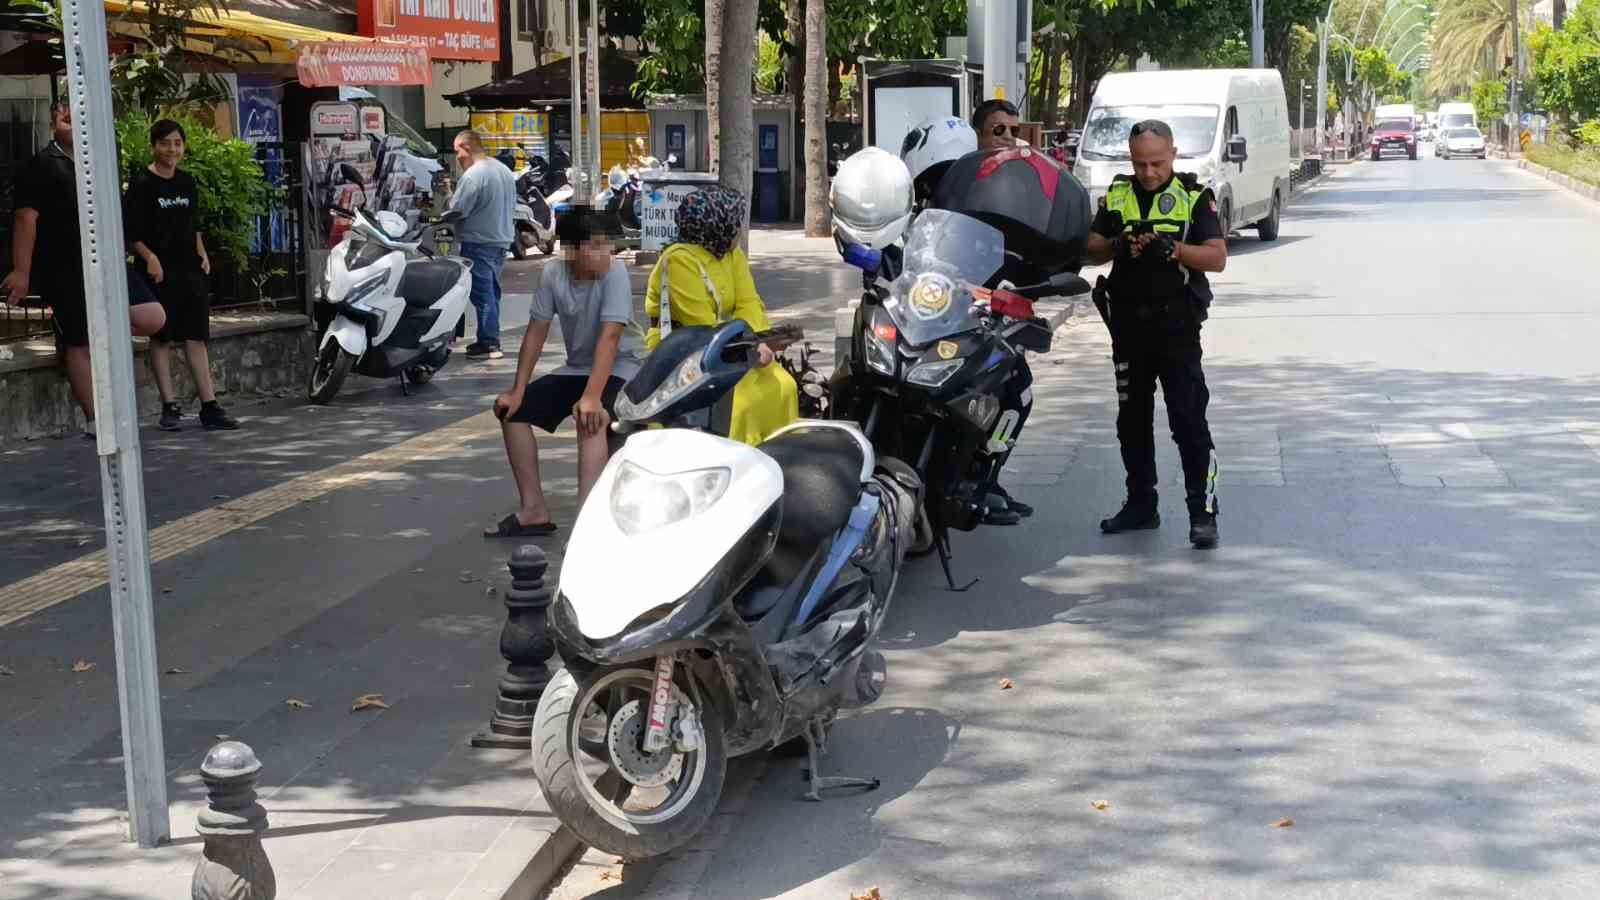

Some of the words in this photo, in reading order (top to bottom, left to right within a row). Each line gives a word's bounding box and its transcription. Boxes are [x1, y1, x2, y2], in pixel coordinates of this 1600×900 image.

[444, 31, 459, 52] TAÇ
[460, 31, 482, 50] BÜFE
[342, 65, 400, 81] DONDURMASI
